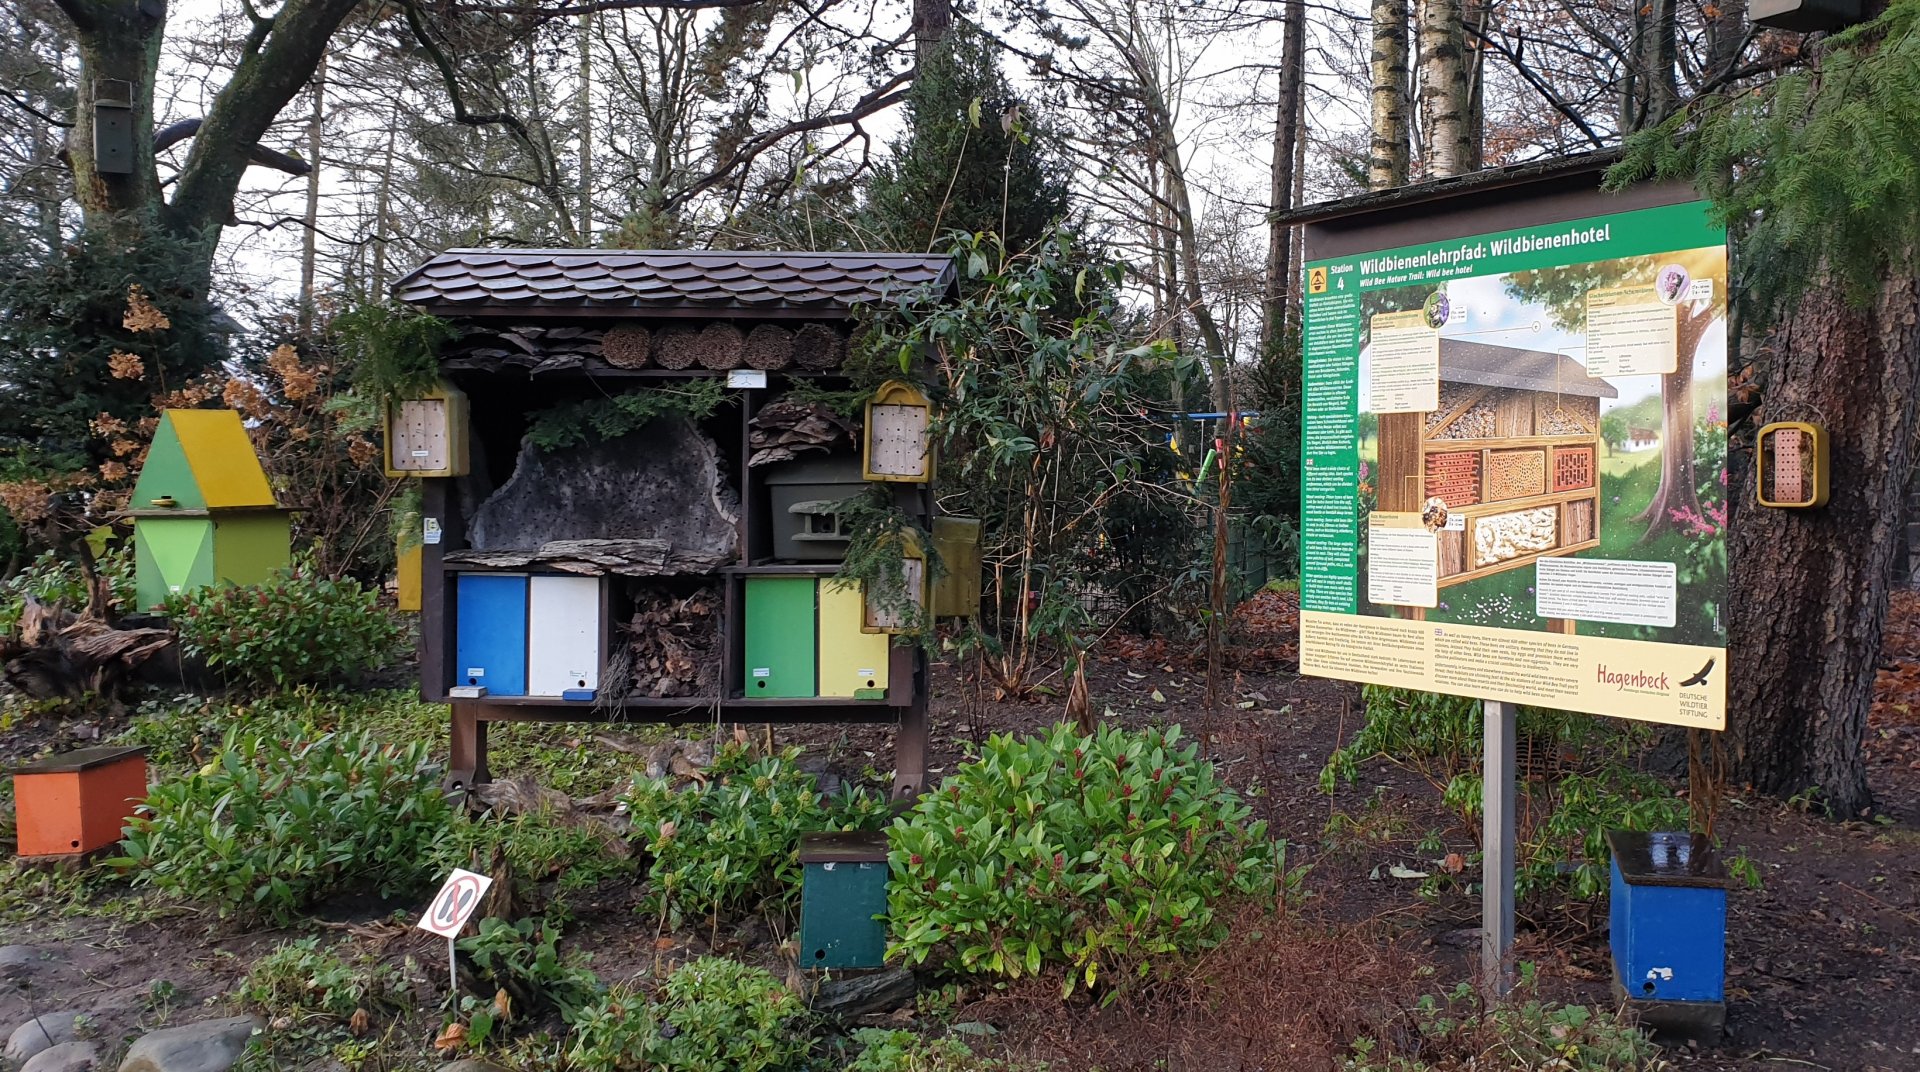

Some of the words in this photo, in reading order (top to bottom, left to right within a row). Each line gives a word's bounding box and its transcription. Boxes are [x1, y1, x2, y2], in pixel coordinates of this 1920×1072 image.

[1360, 242, 1486, 275] Wildbienenlehrpfad:
[1490, 224, 1610, 256] Wildbienenhotel
[1330, 264, 1353, 274] Station
[1360, 278, 1372, 287] Wild
[1374, 278, 1386, 286] Bee
[1387, 275, 1407, 284] Nature
[1408, 272, 1424, 280] Trail:
[1426, 269, 1440, 278] Wild
[1442, 267, 1454, 276] bee
[1455, 264, 1473, 274] hotel
[1337, 276, 1344, 290] 4
[1597, 663, 1670, 691] Hagenbeck
[1679, 692, 1708, 701] DEUTSCHE
[1680, 700, 1708, 710] WILDTIER
[1679, 708, 1708, 718] STIFTUNG
